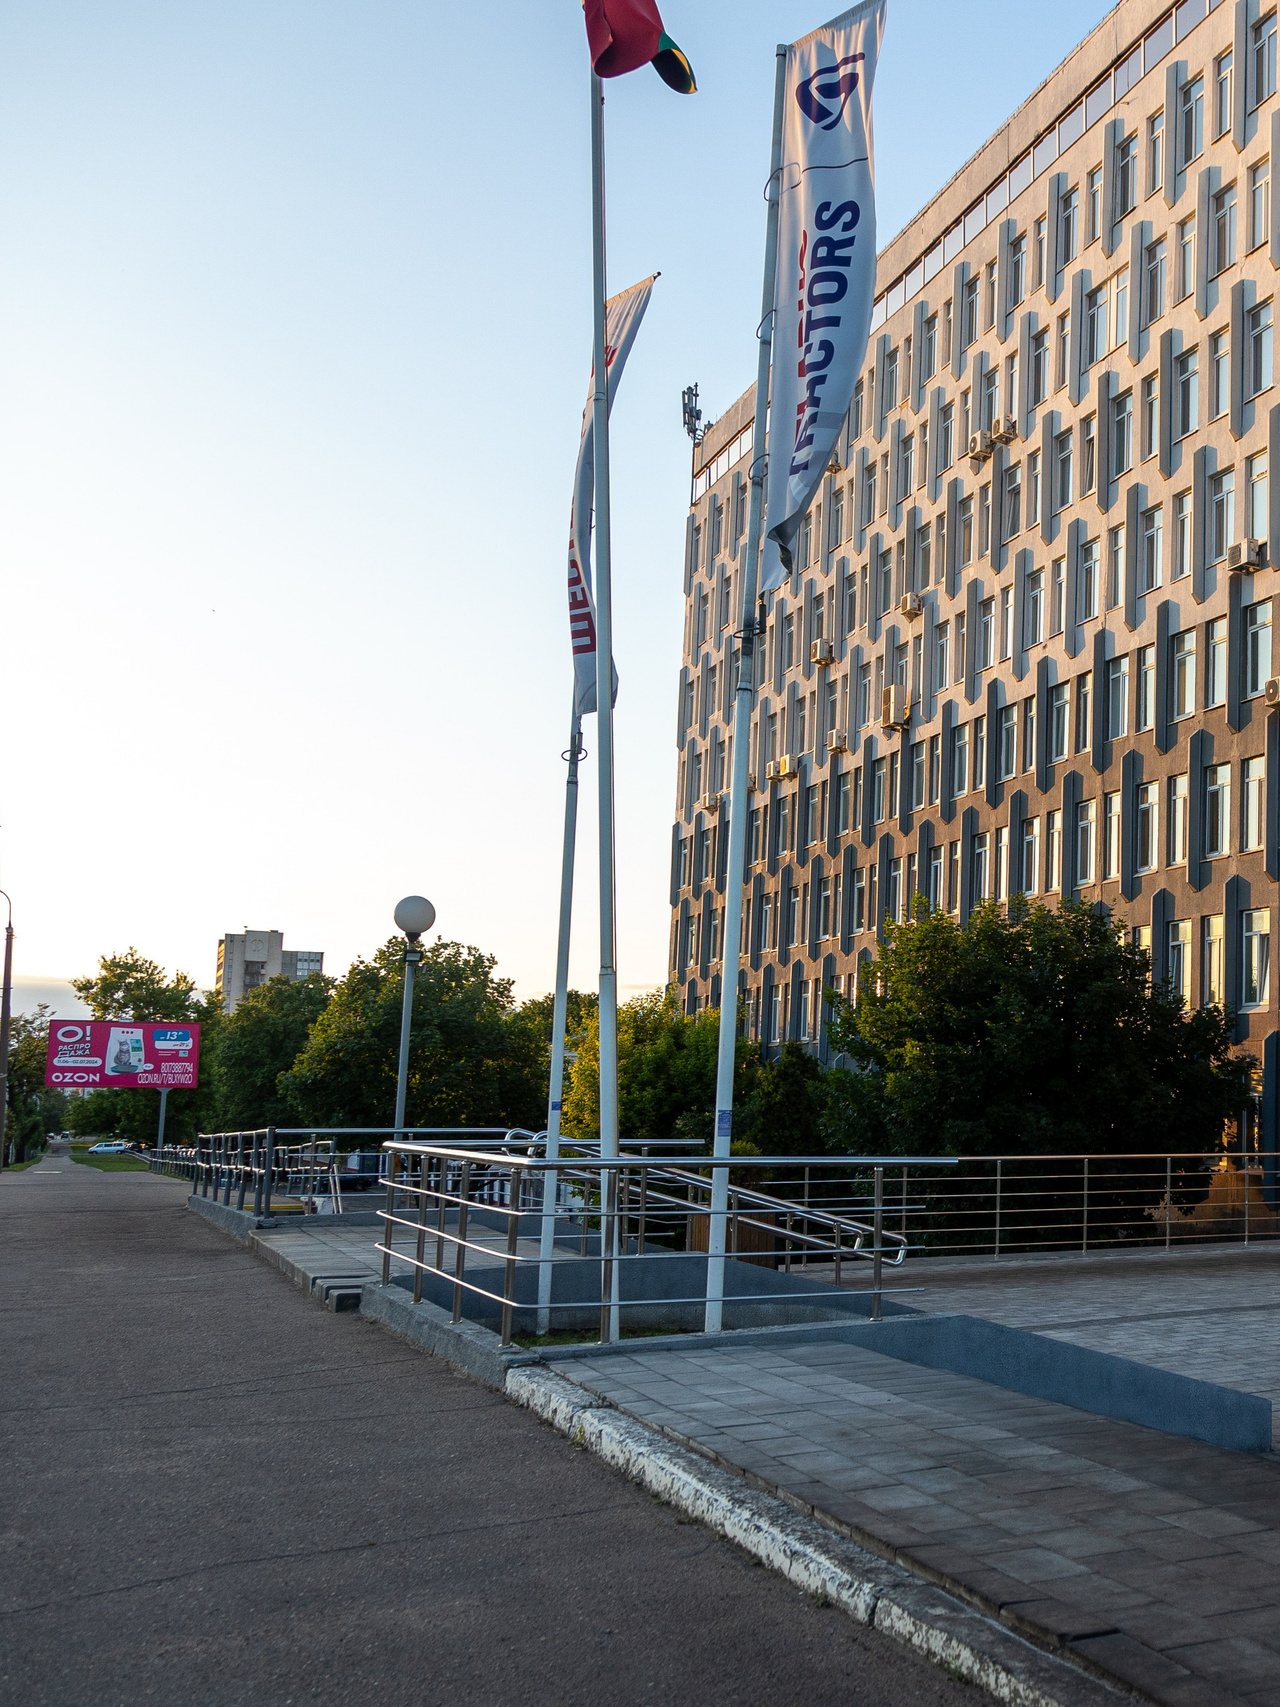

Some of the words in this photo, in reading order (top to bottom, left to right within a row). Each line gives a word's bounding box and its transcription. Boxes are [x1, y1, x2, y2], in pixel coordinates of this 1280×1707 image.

[166, 1031, 178, 1040] 13
[58, 1043, 91, 1051] РАСПРО
[57, 1050, 90, 1058] ДАЖА
[52, 1072, 100, 1083] OZON
